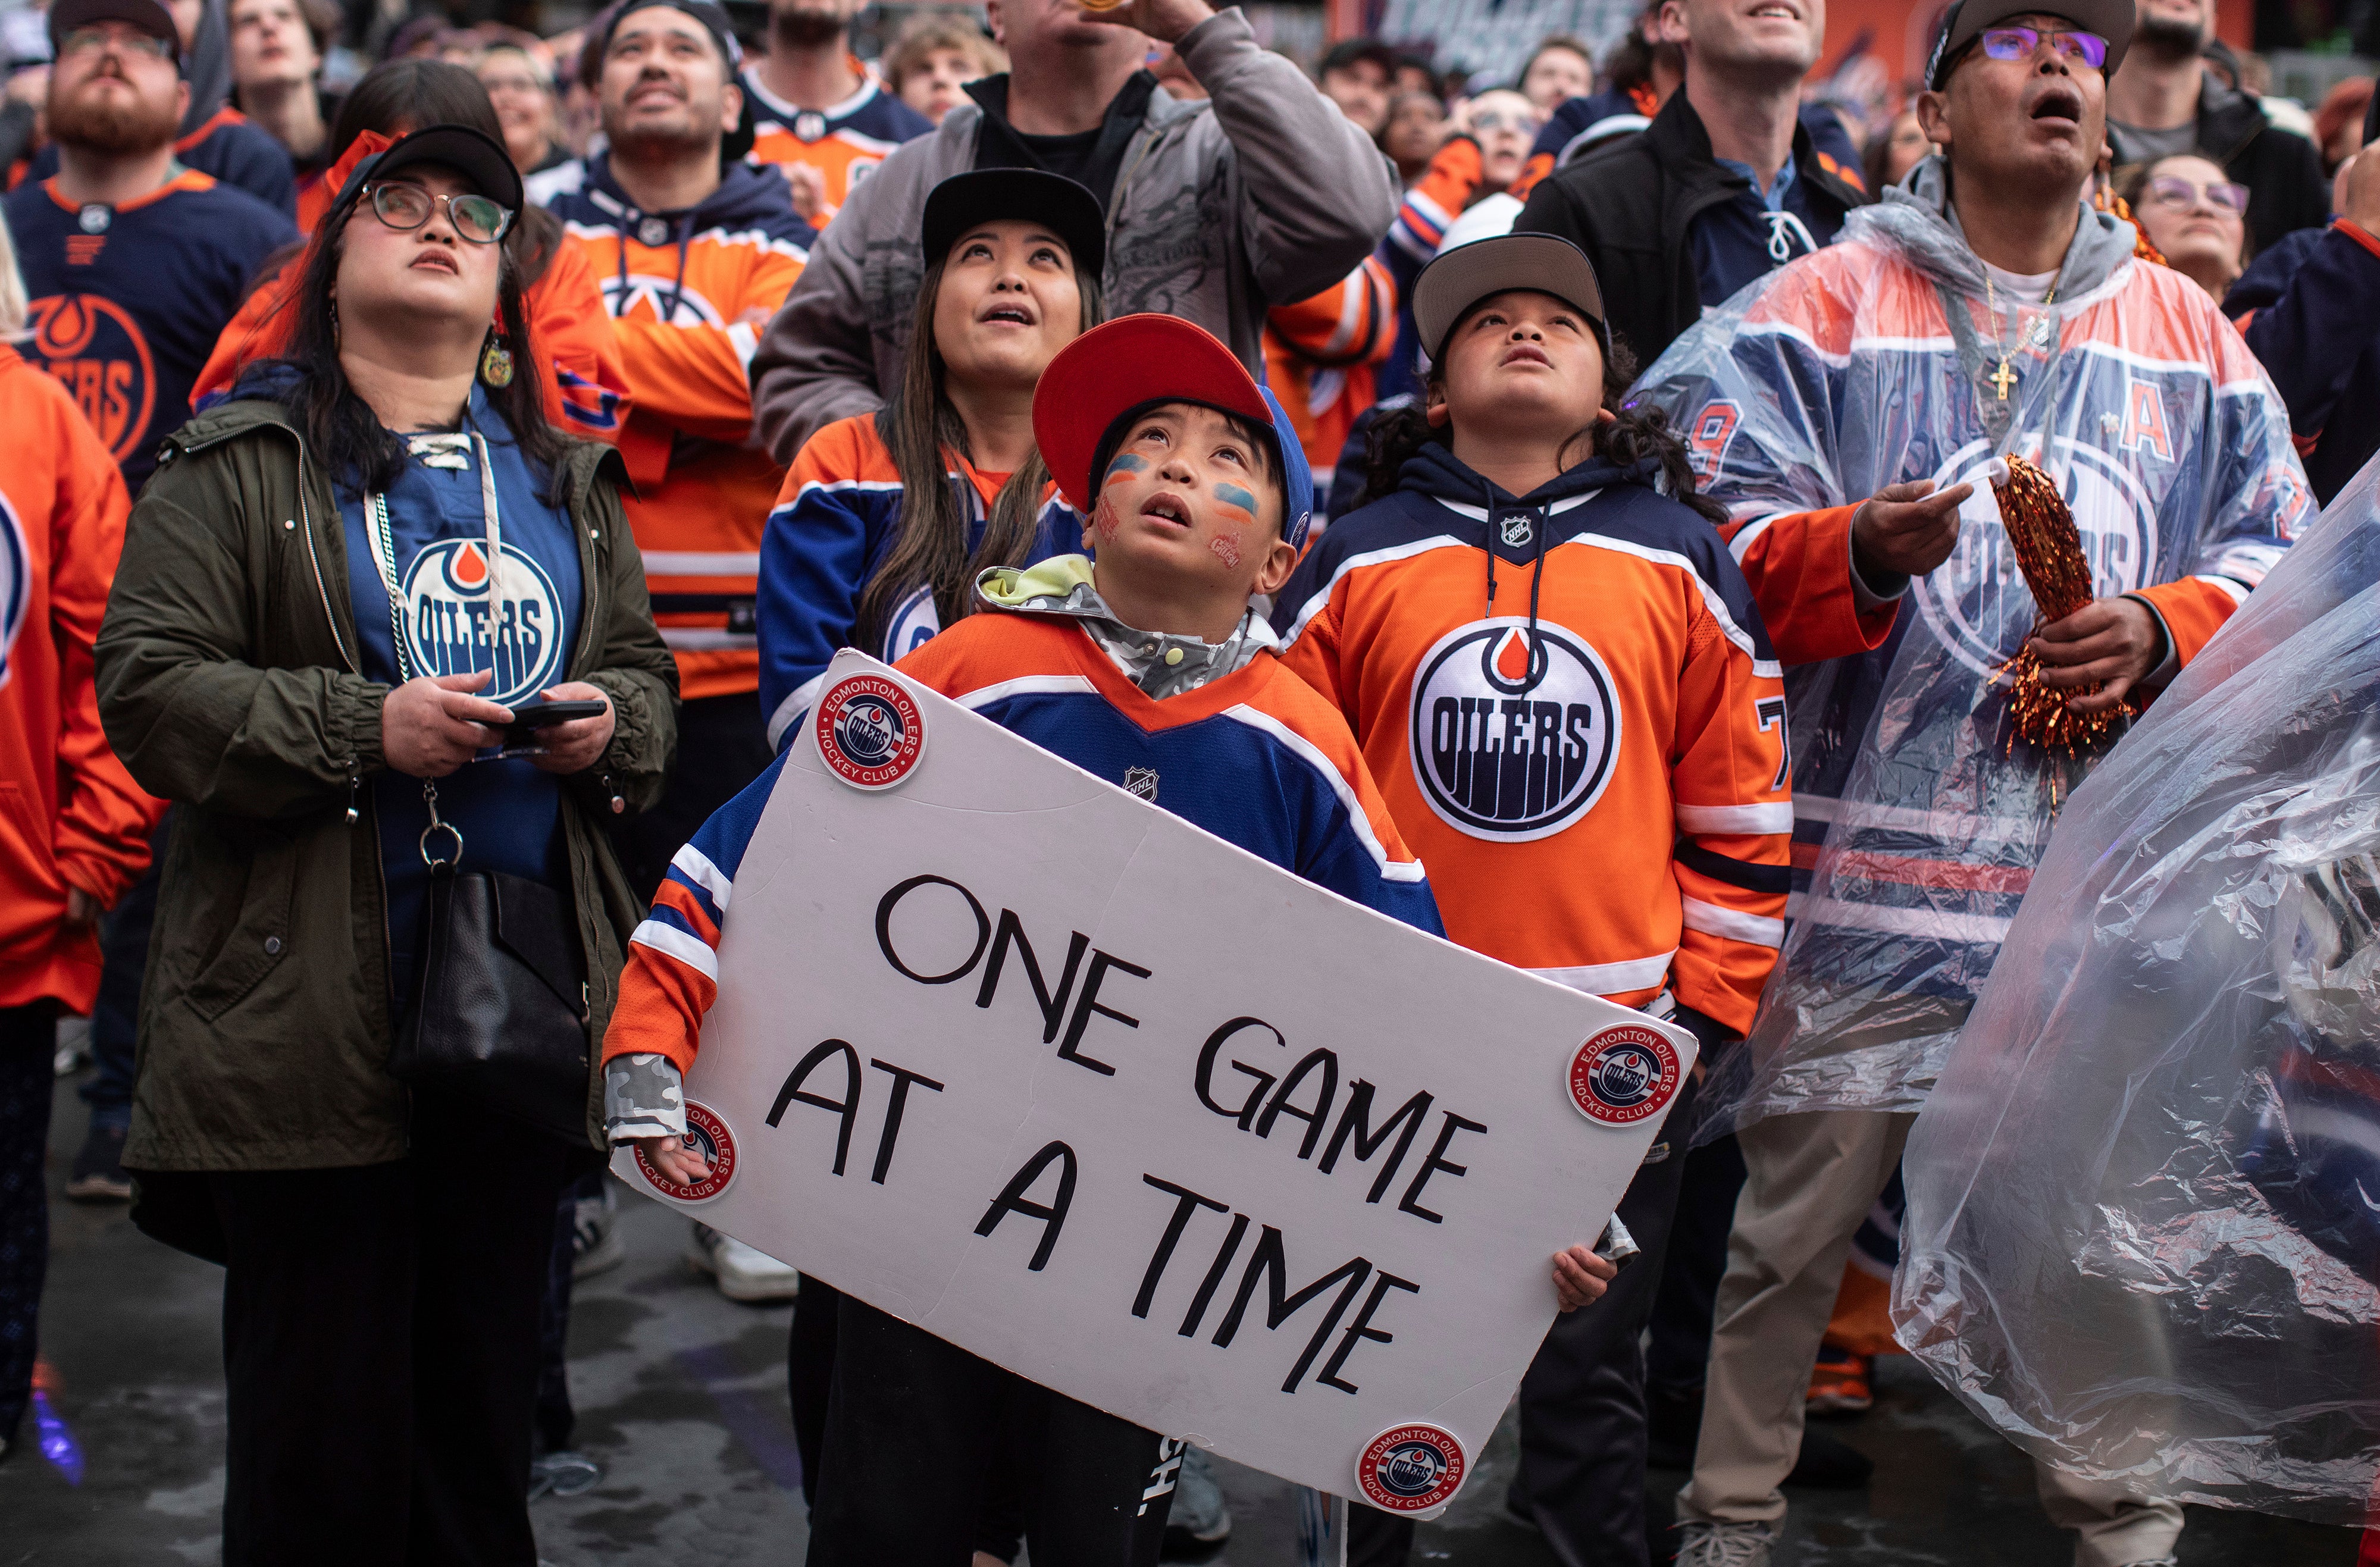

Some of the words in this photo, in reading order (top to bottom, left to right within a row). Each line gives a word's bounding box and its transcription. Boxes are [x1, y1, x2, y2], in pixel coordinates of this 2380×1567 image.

[1688, 397, 1745, 495] 9
[2119, 377, 2175, 463] A
[1508, 524, 1527, 541] NHL
[417, 593, 543, 696] OILERS
[826, 681, 899, 713] EDMONTON
[898, 700, 918, 756] OILERS
[848, 716, 889, 753] OILERS
[1754, 694, 1791, 792] 7
[821, 729, 860, 778] HOCKEY
[862, 765, 899, 782] CLUB
[1432, 697, 1592, 820] OILERS
[1130, 779, 1152, 794] NHL
[875, 874, 1153, 1077] ONE
[1194, 1016, 1488, 1224] GAME
[1580, 1030, 1657, 1064] EDMONTON
[1656, 1044, 1675, 1093] OILERS
[1574, 1078, 1614, 1118] HOCKEY
[1616, 1102, 1654, 1120] CLUB
[1604, 1063, 1645, 1095] OILERS
[710, 1126, 731, 1176] OILERS
[679, 1183, 715, 1196] CLUB
[765, 1038, 945, 1186] AT
[973, 1140, 1078, 1272] A
[1131, 1173, 1421, 1395] TIME
[1368, 1430, 1440, 1461] EDMONTON
[1440, 1440, 1460, 1482] OILERS
[1391, 1459, 1432, 1486] OILERS
[1363, 1474, 1403, 1507] HOCKEY
[1406, 1491, 1442, 1508] CLUB
